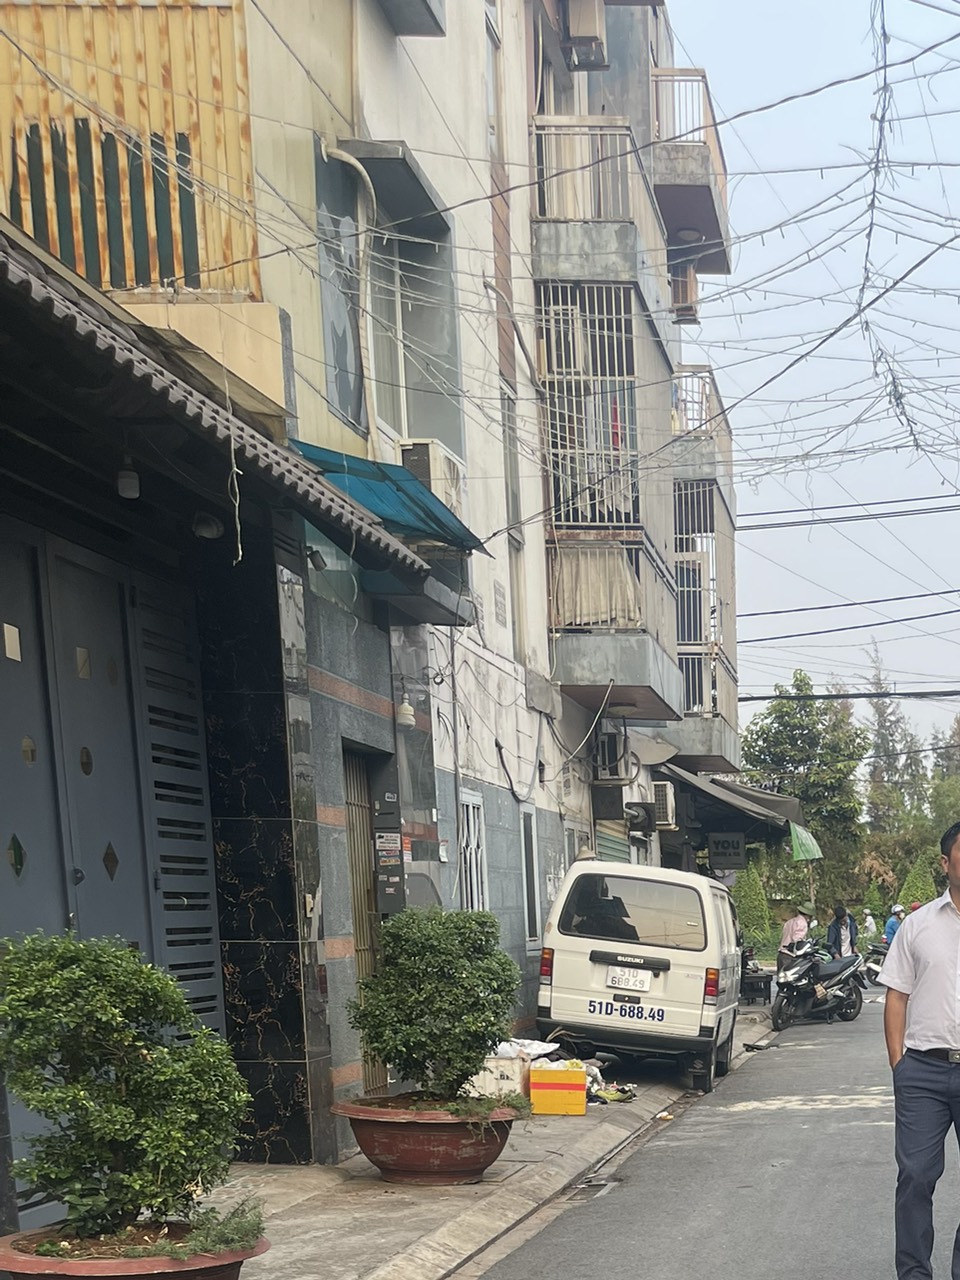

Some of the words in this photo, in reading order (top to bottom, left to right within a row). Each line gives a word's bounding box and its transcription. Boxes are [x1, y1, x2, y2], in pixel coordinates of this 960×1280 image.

[712, 839, 740, 850] YOU
[617, 955, 644, 964] SUZUKI
[619, 968, 639, 979] 51D
[611, 976, 645, 989] 688.49
[588, 999, 665, 1022] 51D-688.49
